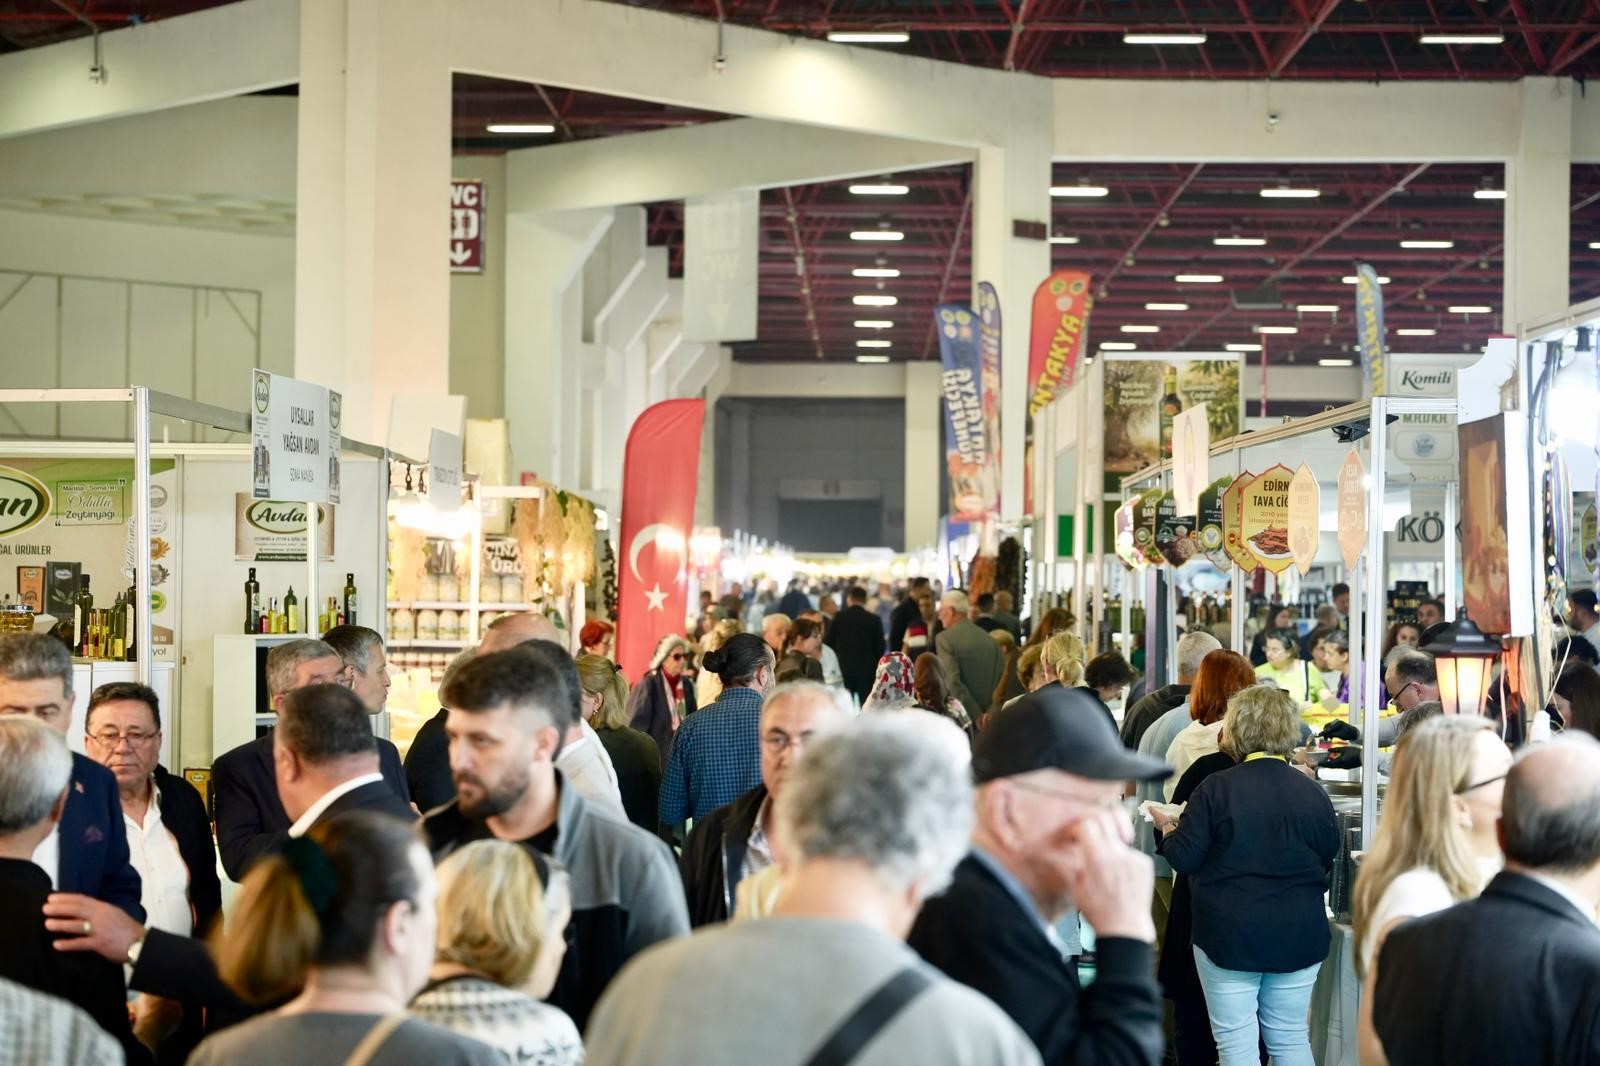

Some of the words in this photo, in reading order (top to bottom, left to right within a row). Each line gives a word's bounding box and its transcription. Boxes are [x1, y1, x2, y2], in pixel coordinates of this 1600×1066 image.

[450, 184, 479, 207] WC
[1029, 313, 1081, 417] ANTAKYA
[1402, 370, 1452, 391] Komili
[290, 406, 315, 427] UYSALLAR
[1253, 495, 1274, 507] TAVA
[1397, 510, 1463, 543] KÖ
[15, 543, 52, 556] ÜRÜNLER
